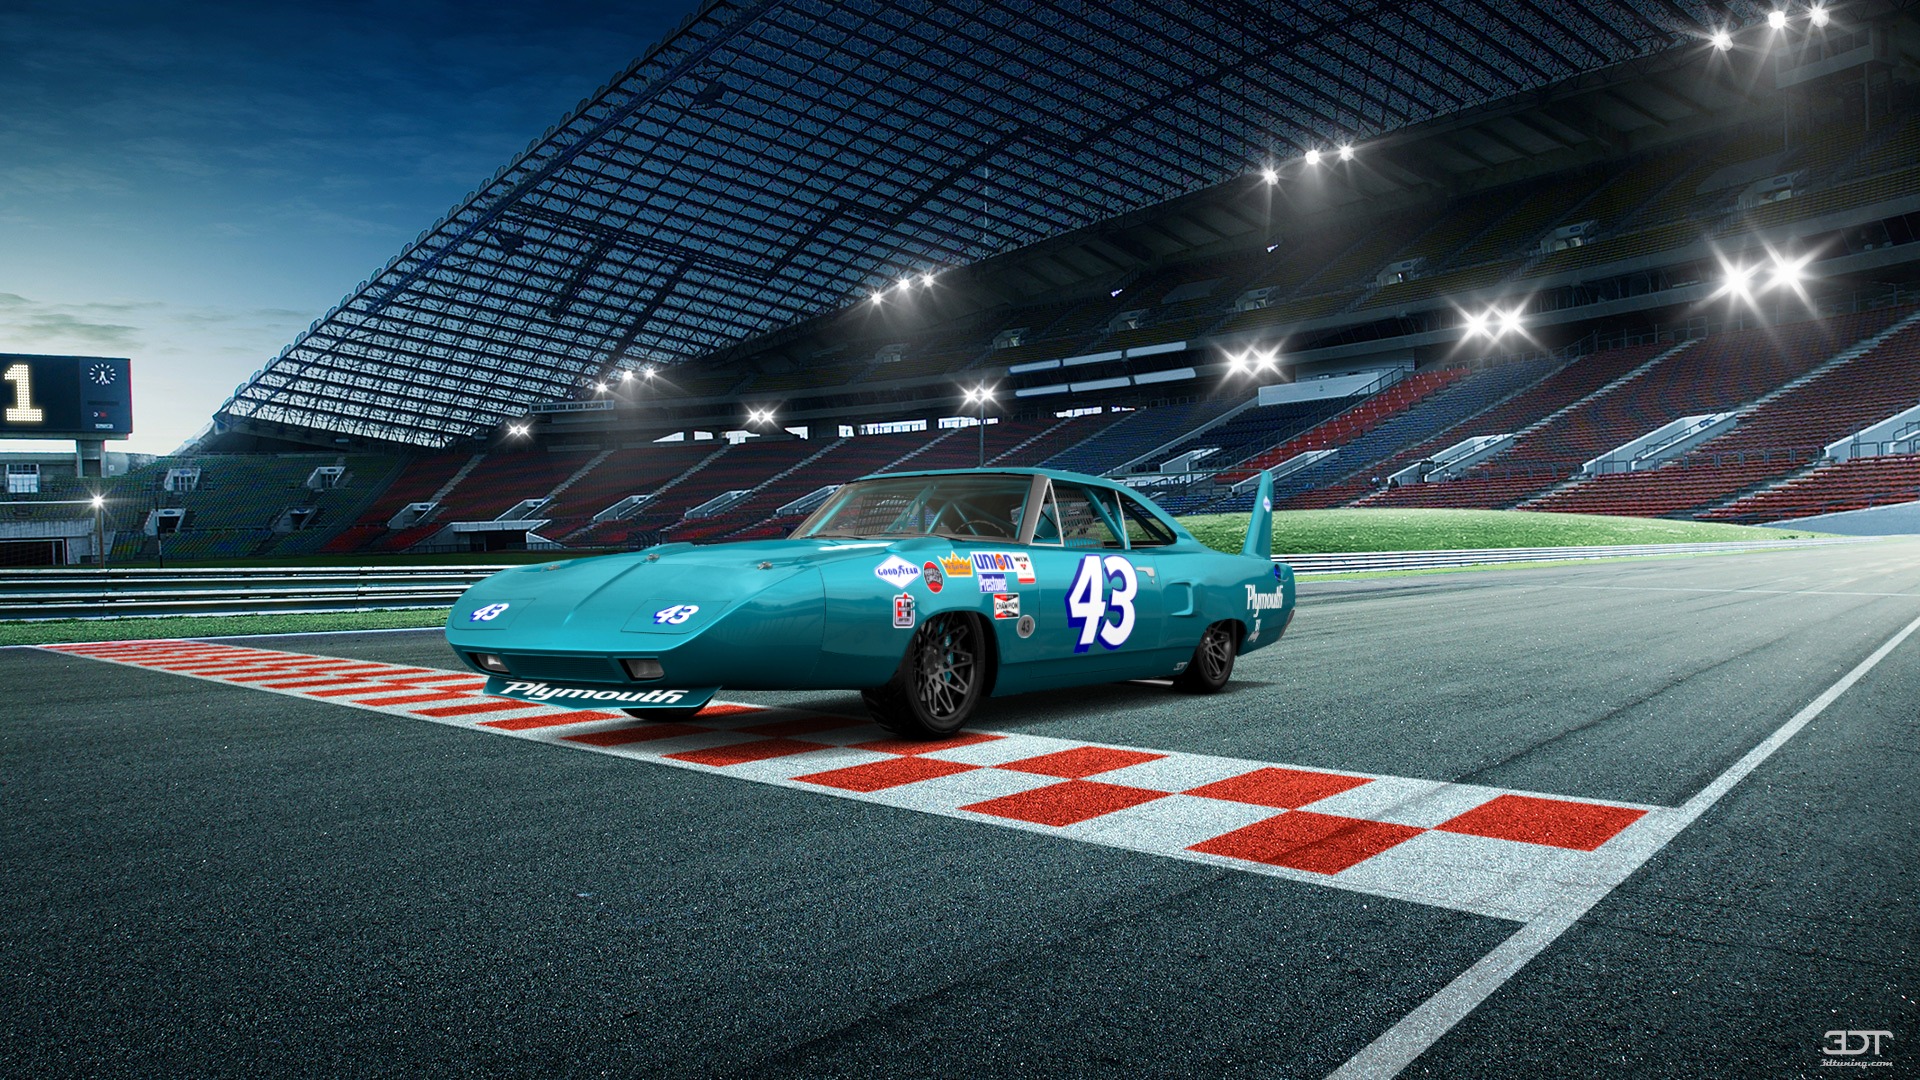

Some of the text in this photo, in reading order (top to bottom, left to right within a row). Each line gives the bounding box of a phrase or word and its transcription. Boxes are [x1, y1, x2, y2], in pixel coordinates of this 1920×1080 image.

[4, 364, 43, 422] 1
[877, 565, 919, 578] GOODYEAR
[973, 553, 1014, 571] UNION
[978, 574, 1007, 591] Prestone
[996, 601, 1018, 610] CHAMPION
[1064, 553, 1138, 654] 43
[1244, 584, 1284, 618] Plymouth
[469, 602, 510, 623] 43
[652, 604, 700, 625] 43
[1021, 620, 1031, 634] 43
[499, 681, 691, 704] Plymouth
